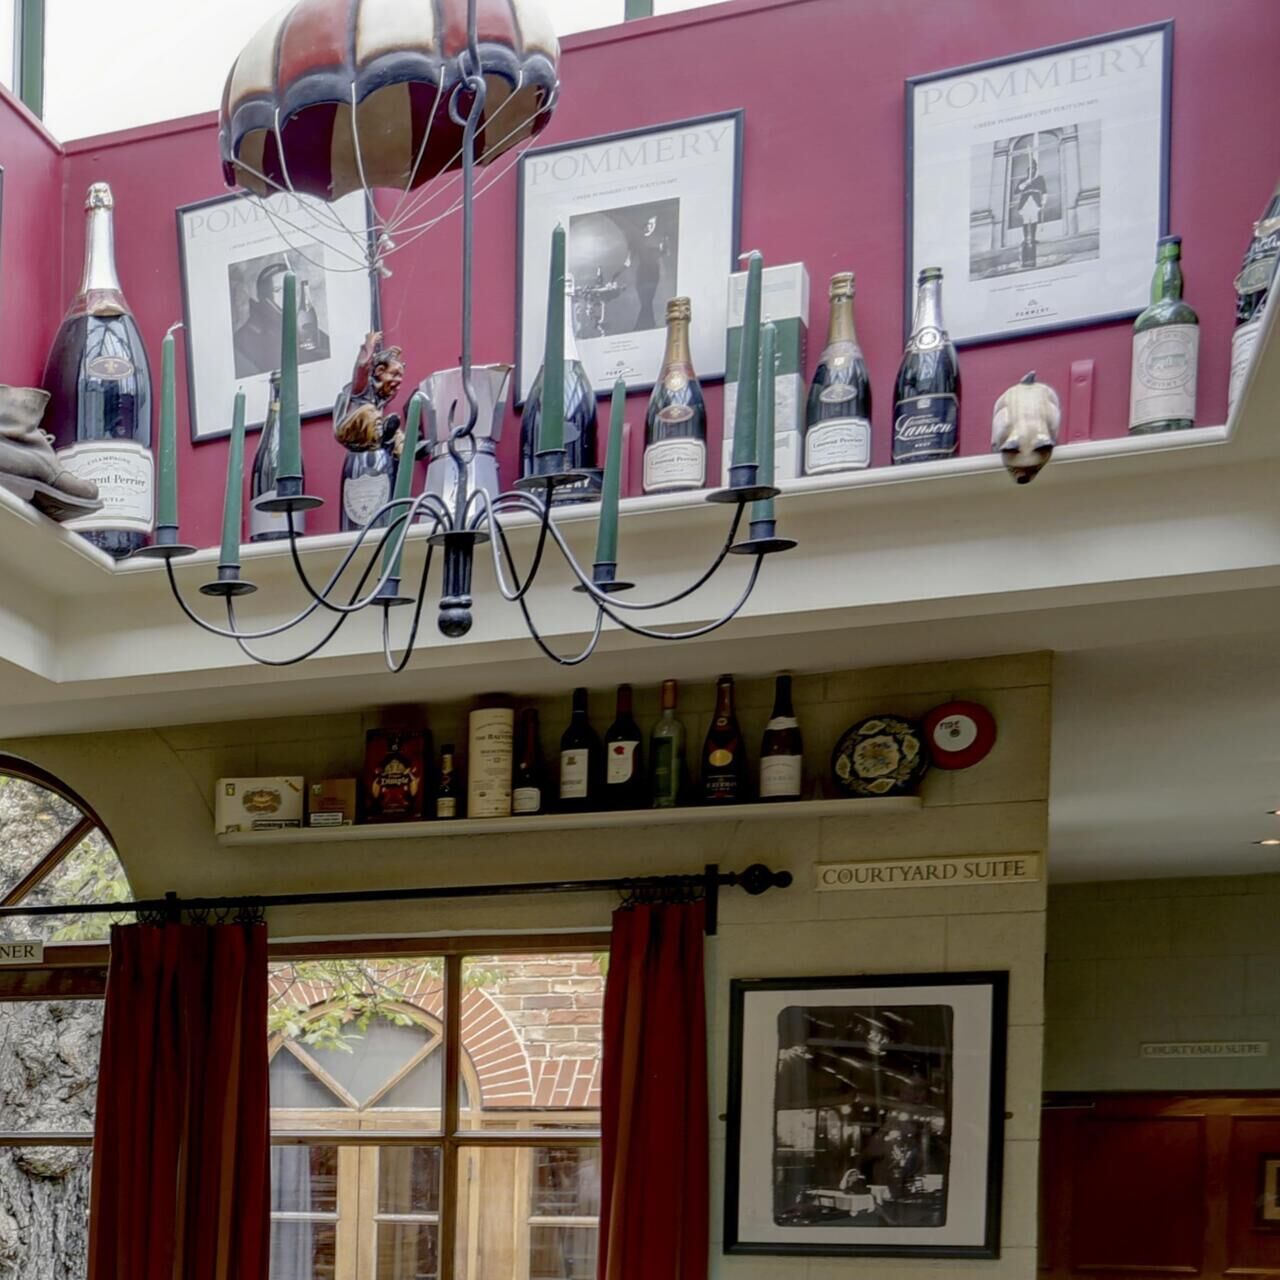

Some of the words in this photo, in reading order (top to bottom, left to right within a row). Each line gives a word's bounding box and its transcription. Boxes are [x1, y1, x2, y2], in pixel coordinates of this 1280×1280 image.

[922, 39, 1157, 116] POMMERY
[530, 126, 730, 187] POMMERY
[895, 414, 953, 441] Lanson
[822, 862, 958, 885] COURTYARD
[964, 859, 1026, 879] SUITE
